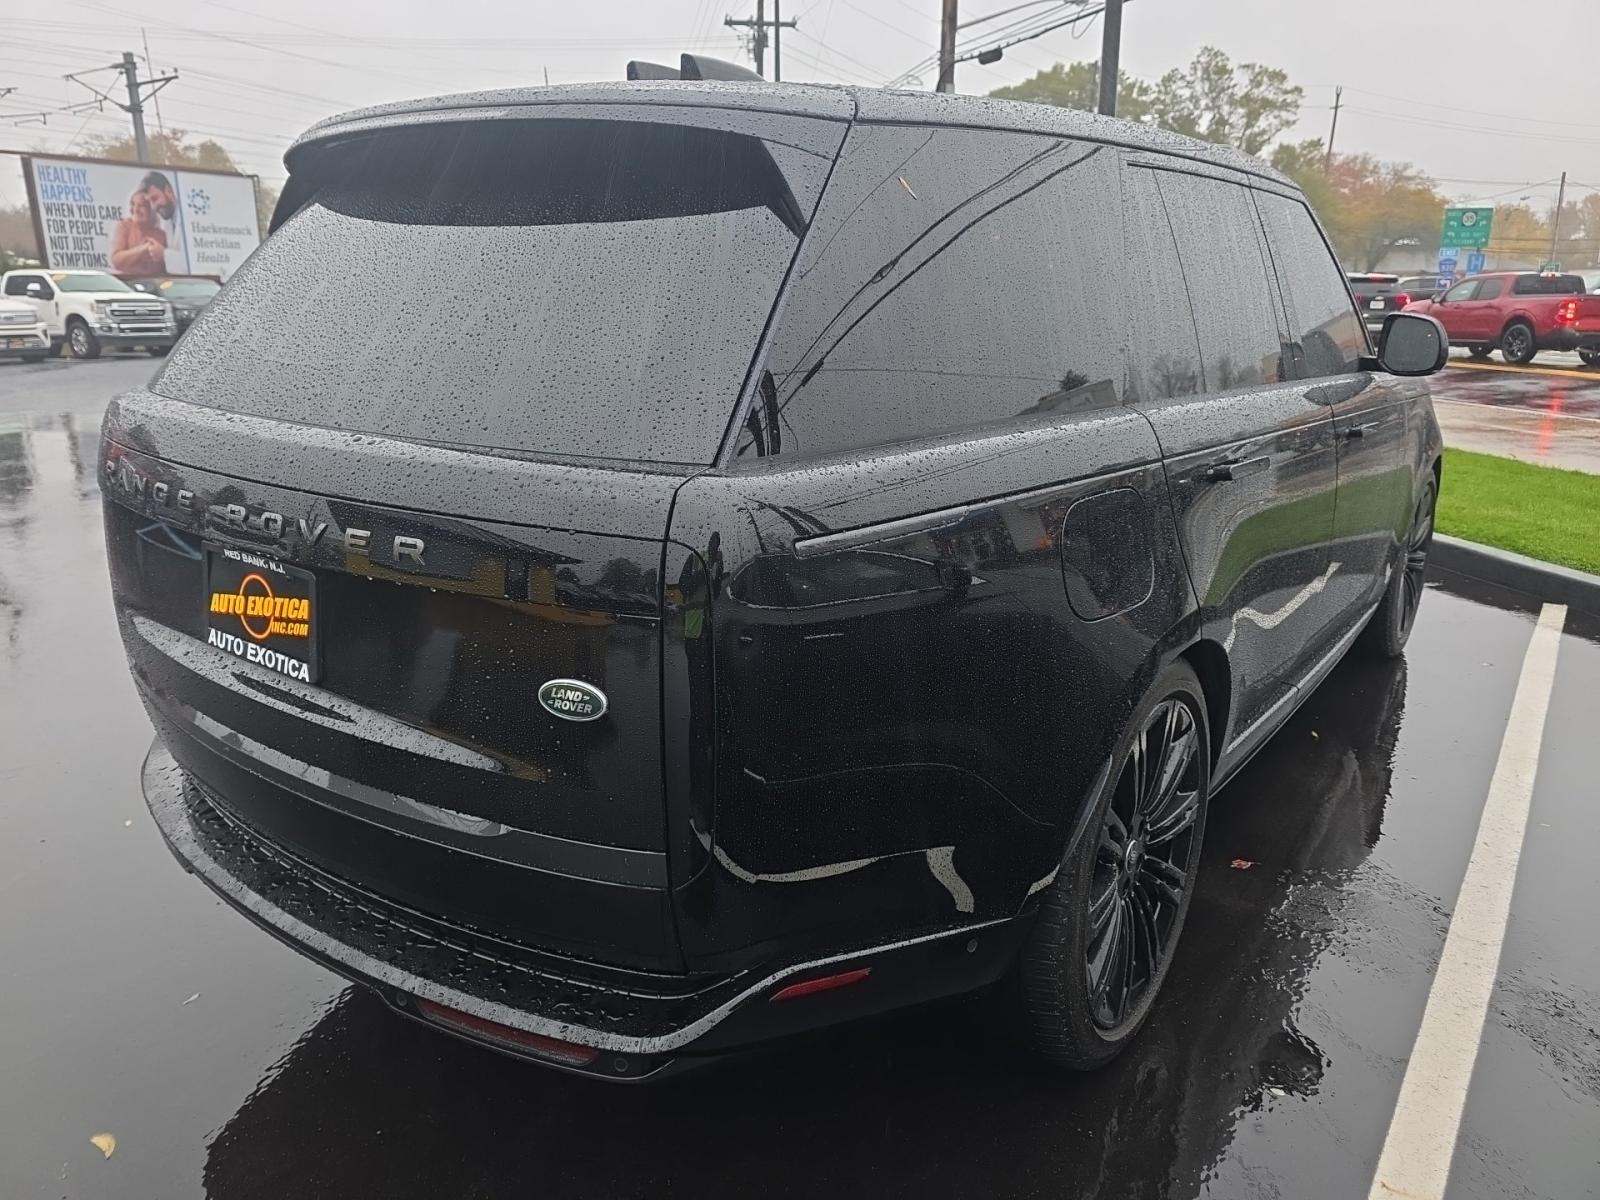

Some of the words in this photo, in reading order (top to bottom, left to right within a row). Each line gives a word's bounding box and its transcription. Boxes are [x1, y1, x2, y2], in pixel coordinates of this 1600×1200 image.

[37, 163, 87, 185] HEALTHY
[40, 183, 94, 203] HAPPENS
[43, 202, 75, 218] WHEN
[76, 204, 97, 219] YOU
[98, 205, 122, 220] CARE
[46, 218, 67, 234] FOR
[49, 235, 69, 251] NOT
[72, 236, 95, 252] JUST
[193, 237, 241, 249] Meridian
[53, 252, 111, 268] SYMPTOMS.
[196, 251, 231, 264] Health
[226, 503, 426, 566] ROVER
[223, 549, 241, 561] RED
[210, 593, 245, 616] AUTO
[247, 595, 310, 620] EXOTICA
[269, 621, 309, 638] INC.COM
[208, 628, 244, 656] AUTO
[246, 643, 310, 682] EXOTICA
[554, 698, 593, 713] ROVER
